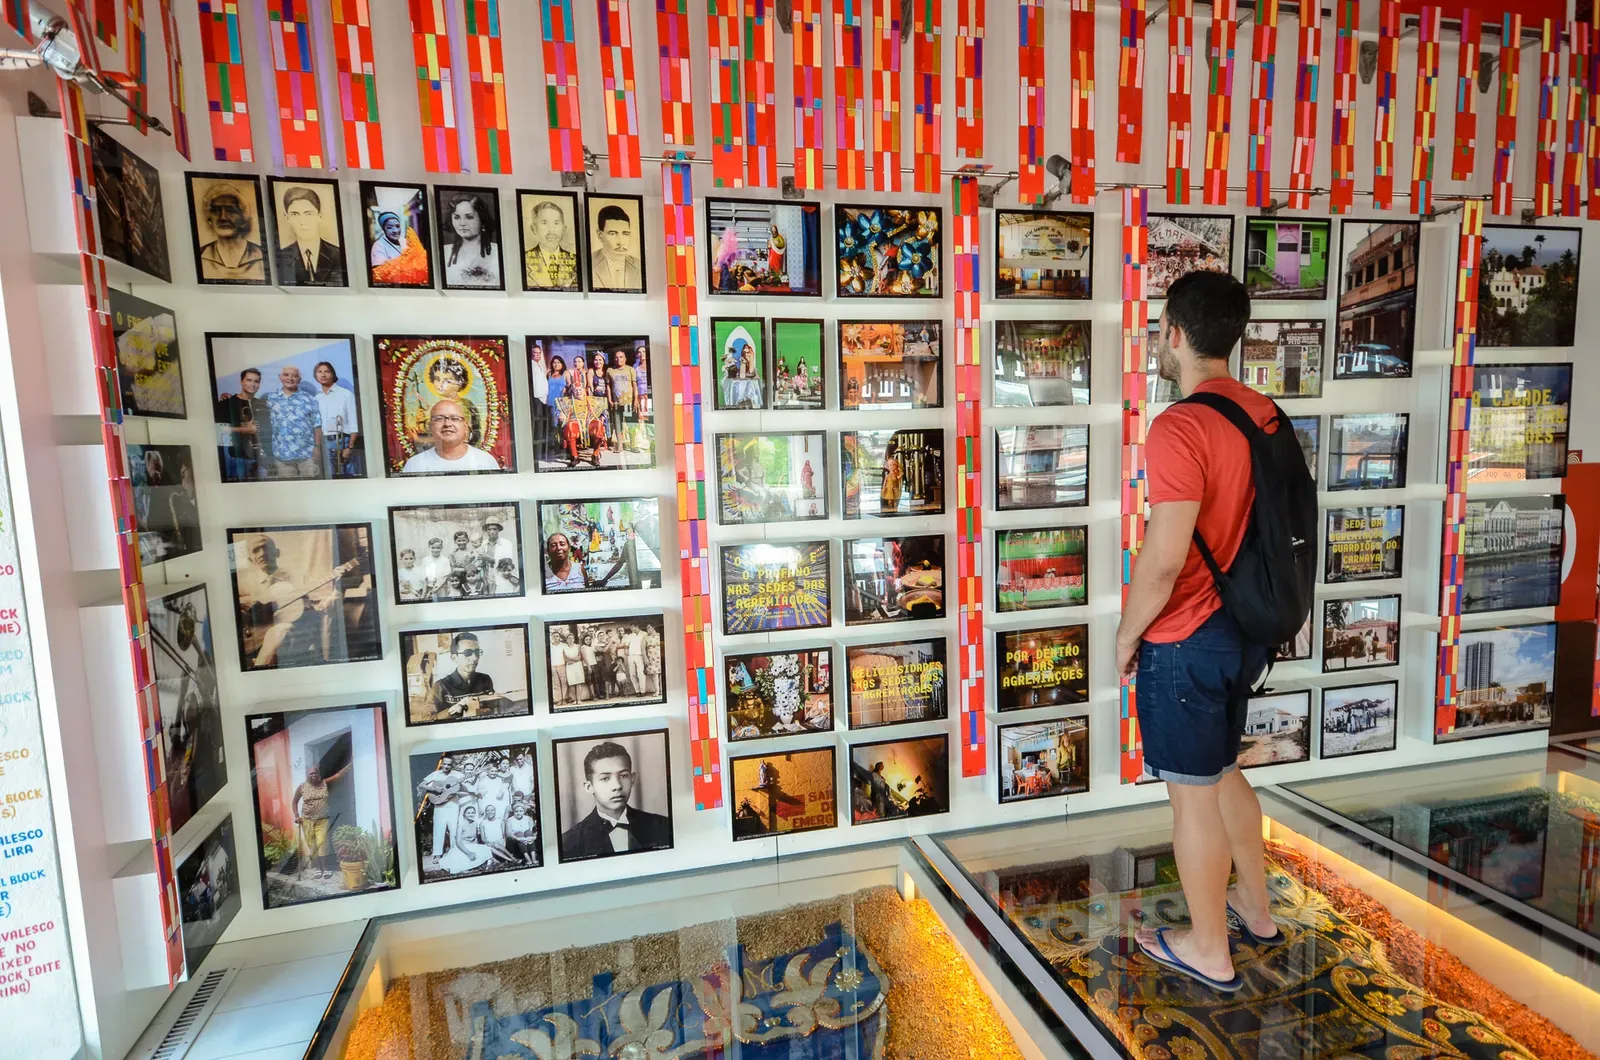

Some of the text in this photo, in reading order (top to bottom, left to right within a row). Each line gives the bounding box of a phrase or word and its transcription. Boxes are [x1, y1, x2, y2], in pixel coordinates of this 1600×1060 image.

[1344, 519, 1366, 529] SEDE
[1332, 540, 1397, 553] GUARDIÕES DO
[1343, 553, 1385, 564] CARNAVAL
[727, 579, 825, 596] NAS SEDES DAS
[1006, 645, 1080, 663] POR DENTRO
[852, 661, 942, 679] RELIGIOSIDADES
[1032, 661, 1055, 672] DAS
[854, 679, 876, 690] NAS
[882, 674, 915, 686] SEDES
[1003, 666, 1083, 688] AGREMIAÇÕES
[863, 682, 933, 699] AGREMIAÇÕES
[6, 788, 43, 804] BLOCK
[4, 844, 33, 859] LIRA
[10, 869, 46, 885] BLOCK
[16, 940, 36, 954] NO
[28, 960, 61, 977] EDITE
